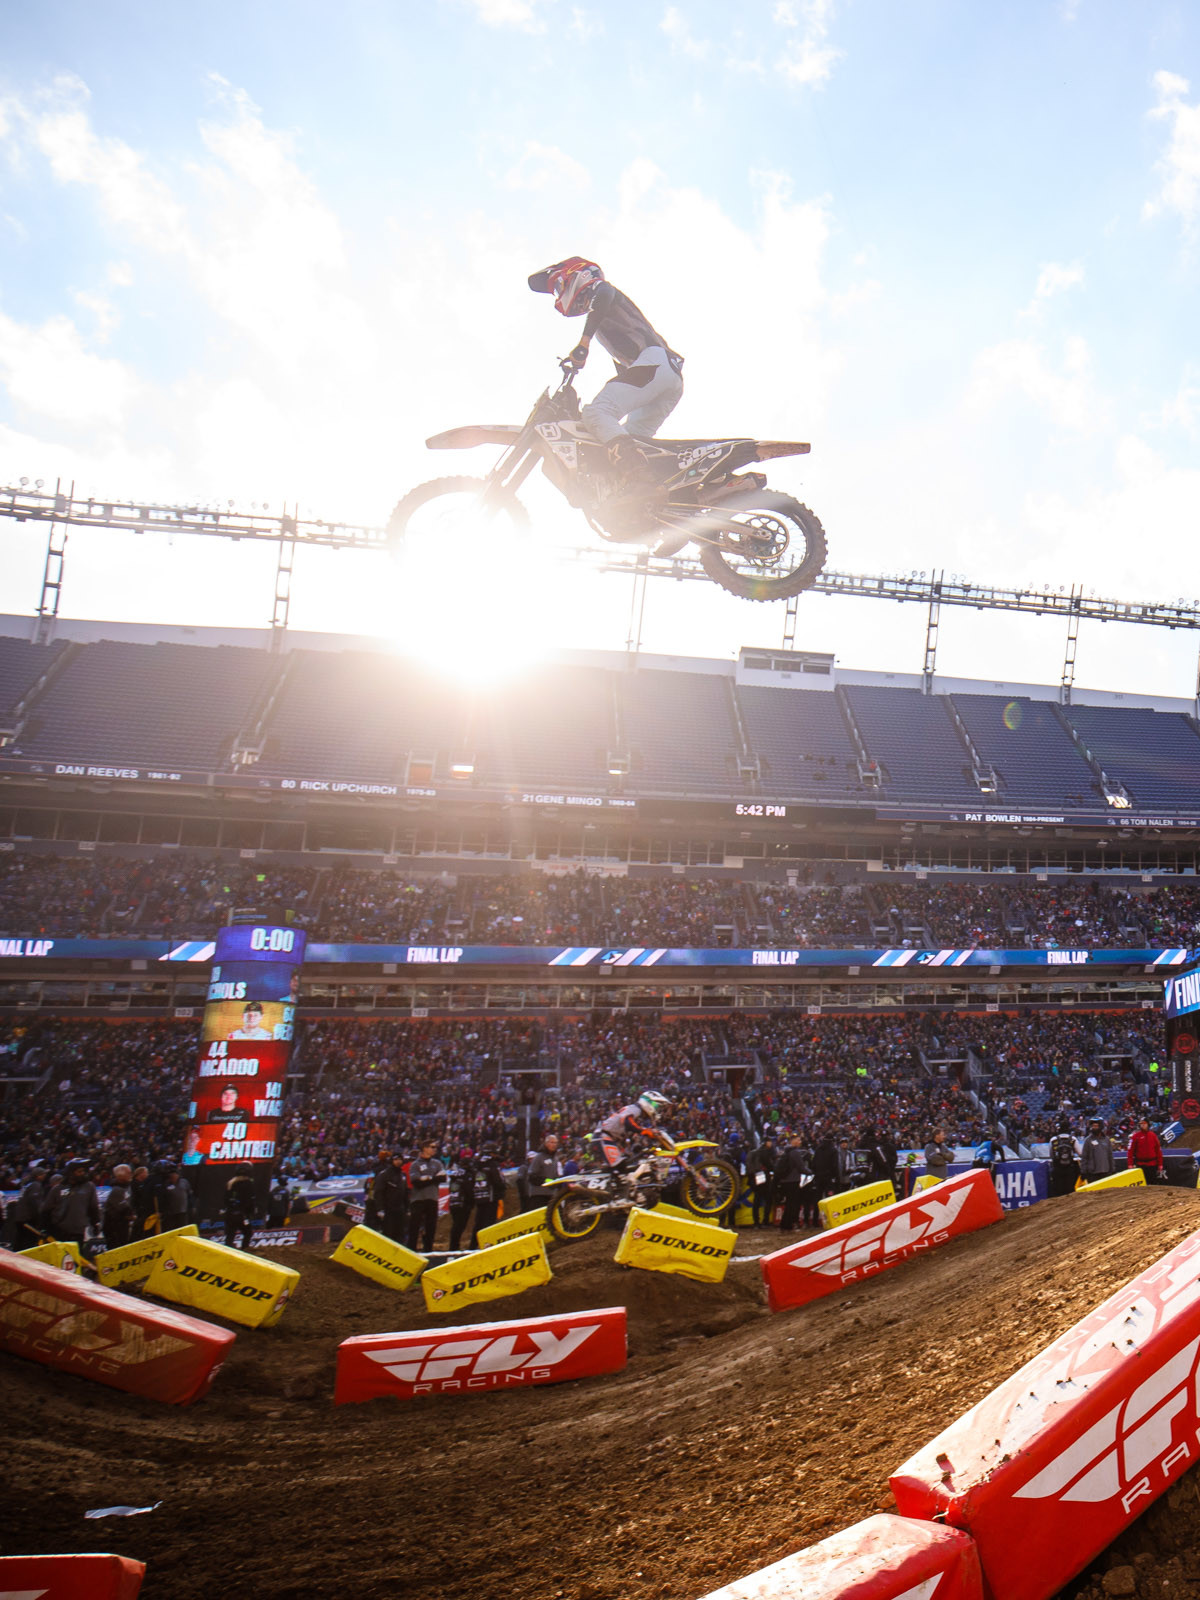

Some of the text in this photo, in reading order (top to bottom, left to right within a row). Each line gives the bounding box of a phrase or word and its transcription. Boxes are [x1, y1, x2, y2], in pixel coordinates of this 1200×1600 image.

[56, 765, 85, 776] DAN
[87, 767, 139, 779] REEVES
[281, 780, 296, 789] 80
[301, 781, 329, 791] RICK
[332, 783, 397, 795] UPCHURCH
[522, 794, 534, 803] 21
[535, 795, 564, 804] GENE
[567, 796, 602, 806] MINGO
[736, 804, 786, 817] 5:42 PM
[965, 813, 982, 822] PAT
[985, 814, 1021, 823] BOWLEN
[1149, 819, 1173, 827] NALEN
[25, 940, 54, 956] LAP
[250, 928, 294, 952] 0:00
[407, 947, 463, 962] FINAL LAP
[752, 951, 799, 965] FINAL LAP
[1047, 951, 1088, 964] FINAL LAP
[208, 1041, 229, 1058] 44
[222, 1122, 247, 1140] 40
[842, 1192, 892, 1215] DUNLOP
[788, 1183, 975, 1276] FLY
[646, 1233, 728, 1258] DUNLOP
[353, 1248, 414, 1279] DUNLOP
[841, 1231, 949, 1285] RACING
[450, 1254, 540, 1295] DUNLOP
[179, 1265, 273, 1302] DUNLOP
[362, 1324, 602, 1382] FLY
[413, 1368, 551, 1394] RACING
